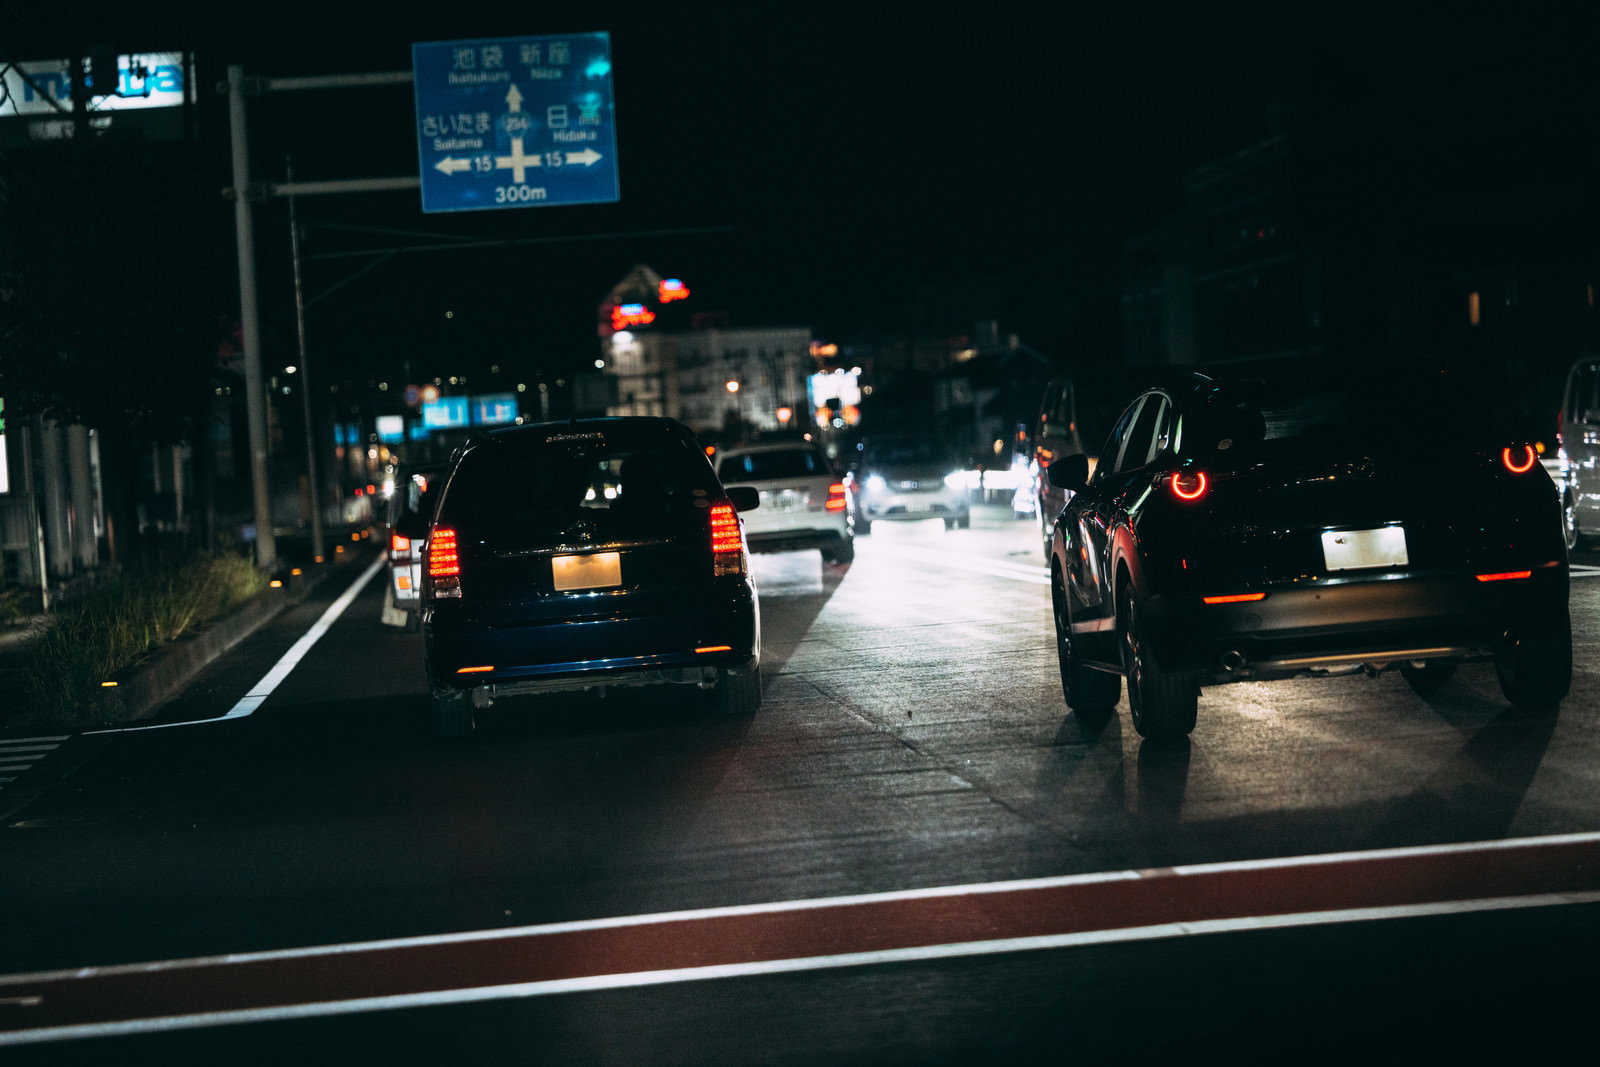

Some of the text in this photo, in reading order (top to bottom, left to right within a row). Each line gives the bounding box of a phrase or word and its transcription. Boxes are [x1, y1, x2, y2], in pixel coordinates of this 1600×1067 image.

[452, 42, 570, 68] 池袋 新座
[423, 113, 490, 137] さいたま
[434, 138, 483, 152] Saitama
[475, 155, 492, 172] 15
[546, 152, 563, 168] 15
[495, 185, 547, 203] 300m
